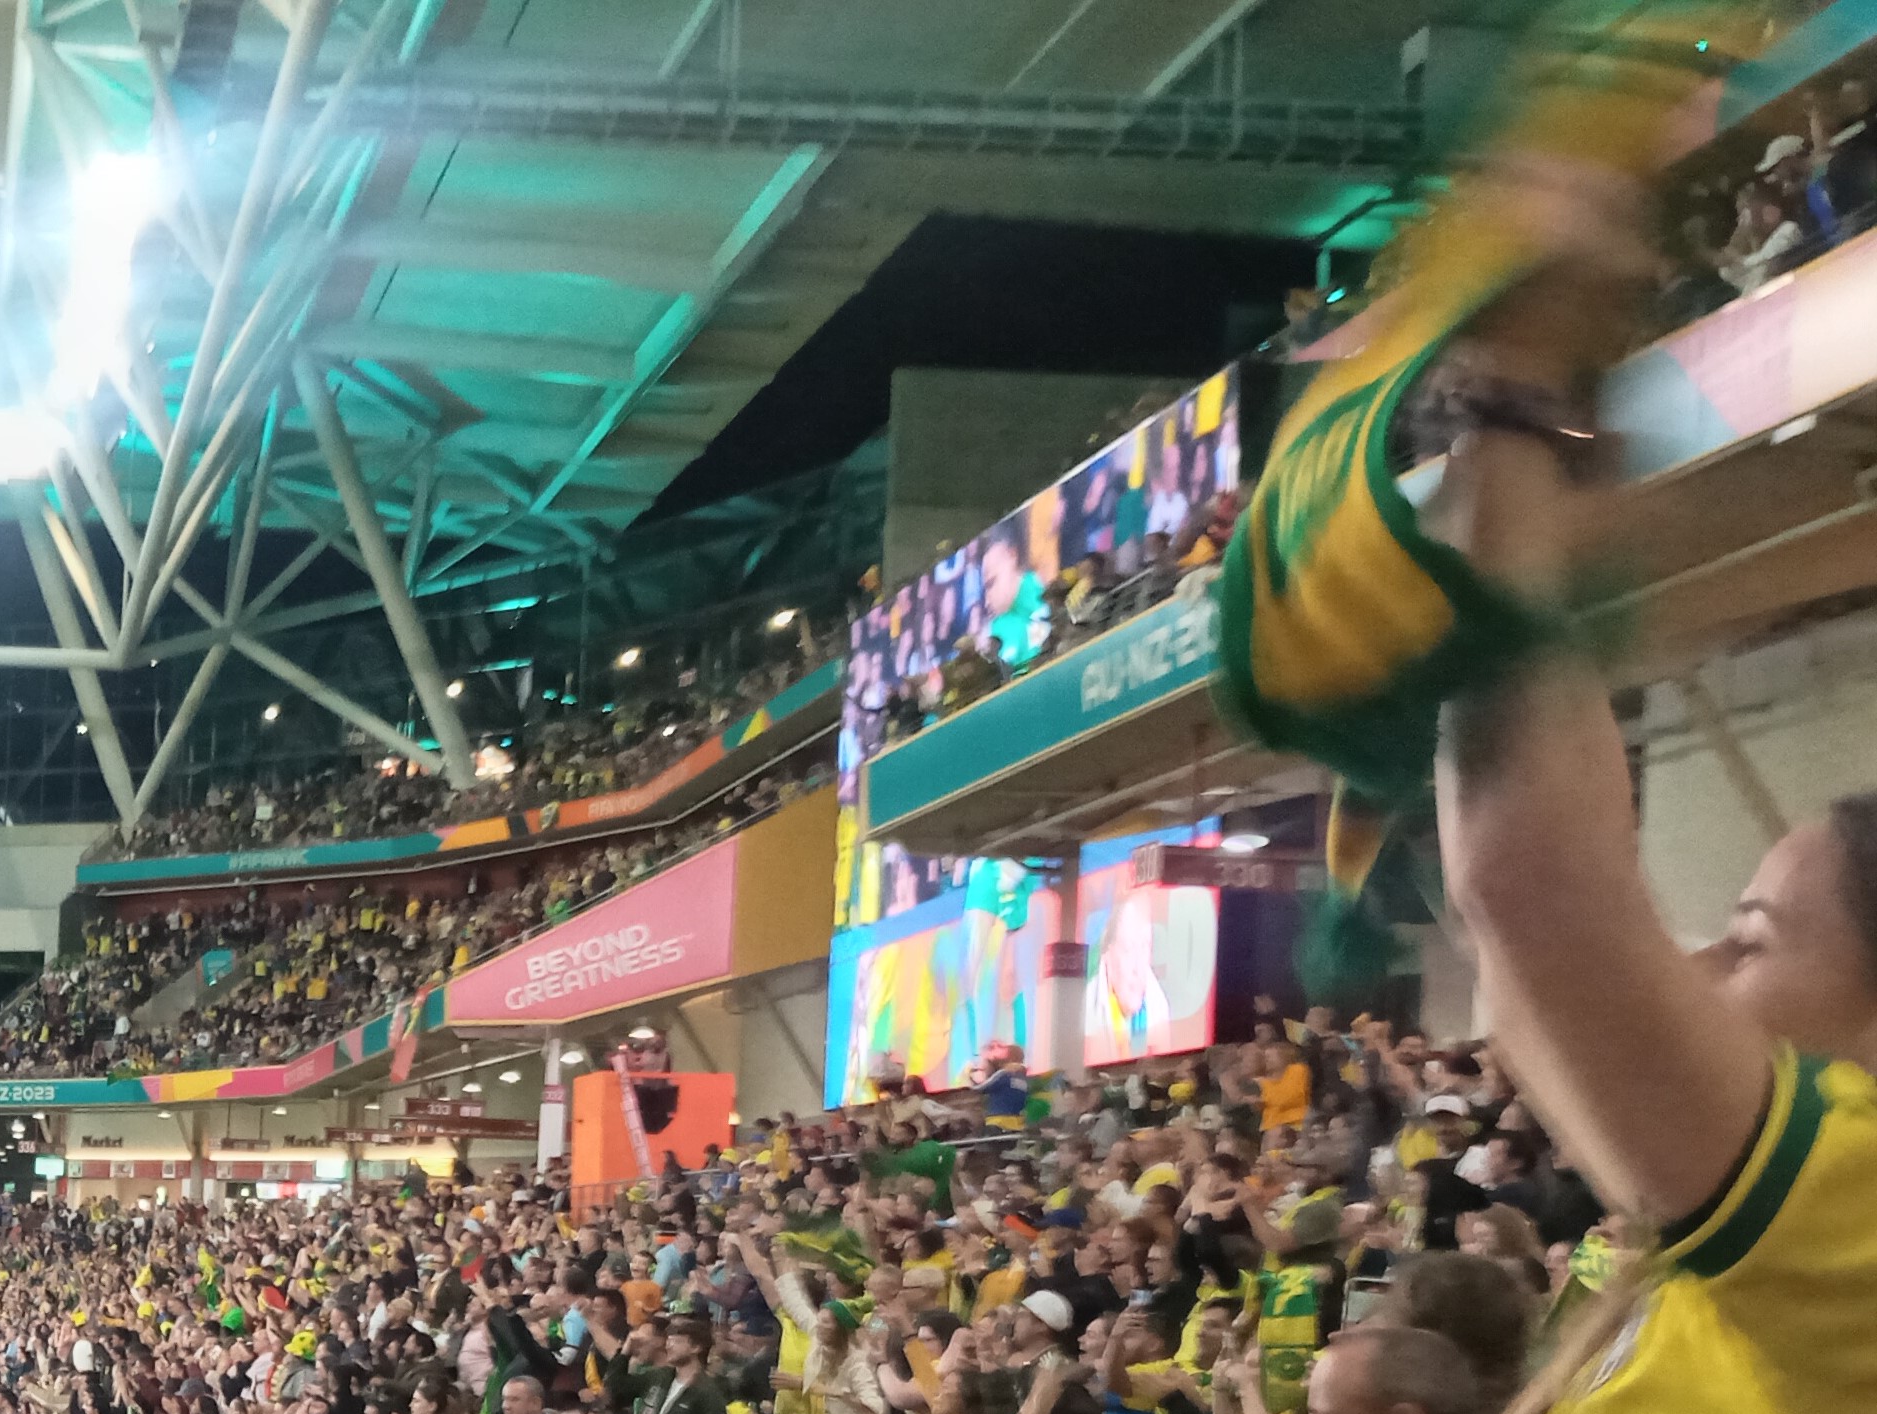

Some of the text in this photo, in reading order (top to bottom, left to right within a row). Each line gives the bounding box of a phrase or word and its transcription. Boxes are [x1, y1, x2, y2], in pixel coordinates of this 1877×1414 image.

[505, 937, 684, 1010] GREATNESS
[526, 924, 650, 980] BEYOND
[81, 1135, 123, 1148] Market
